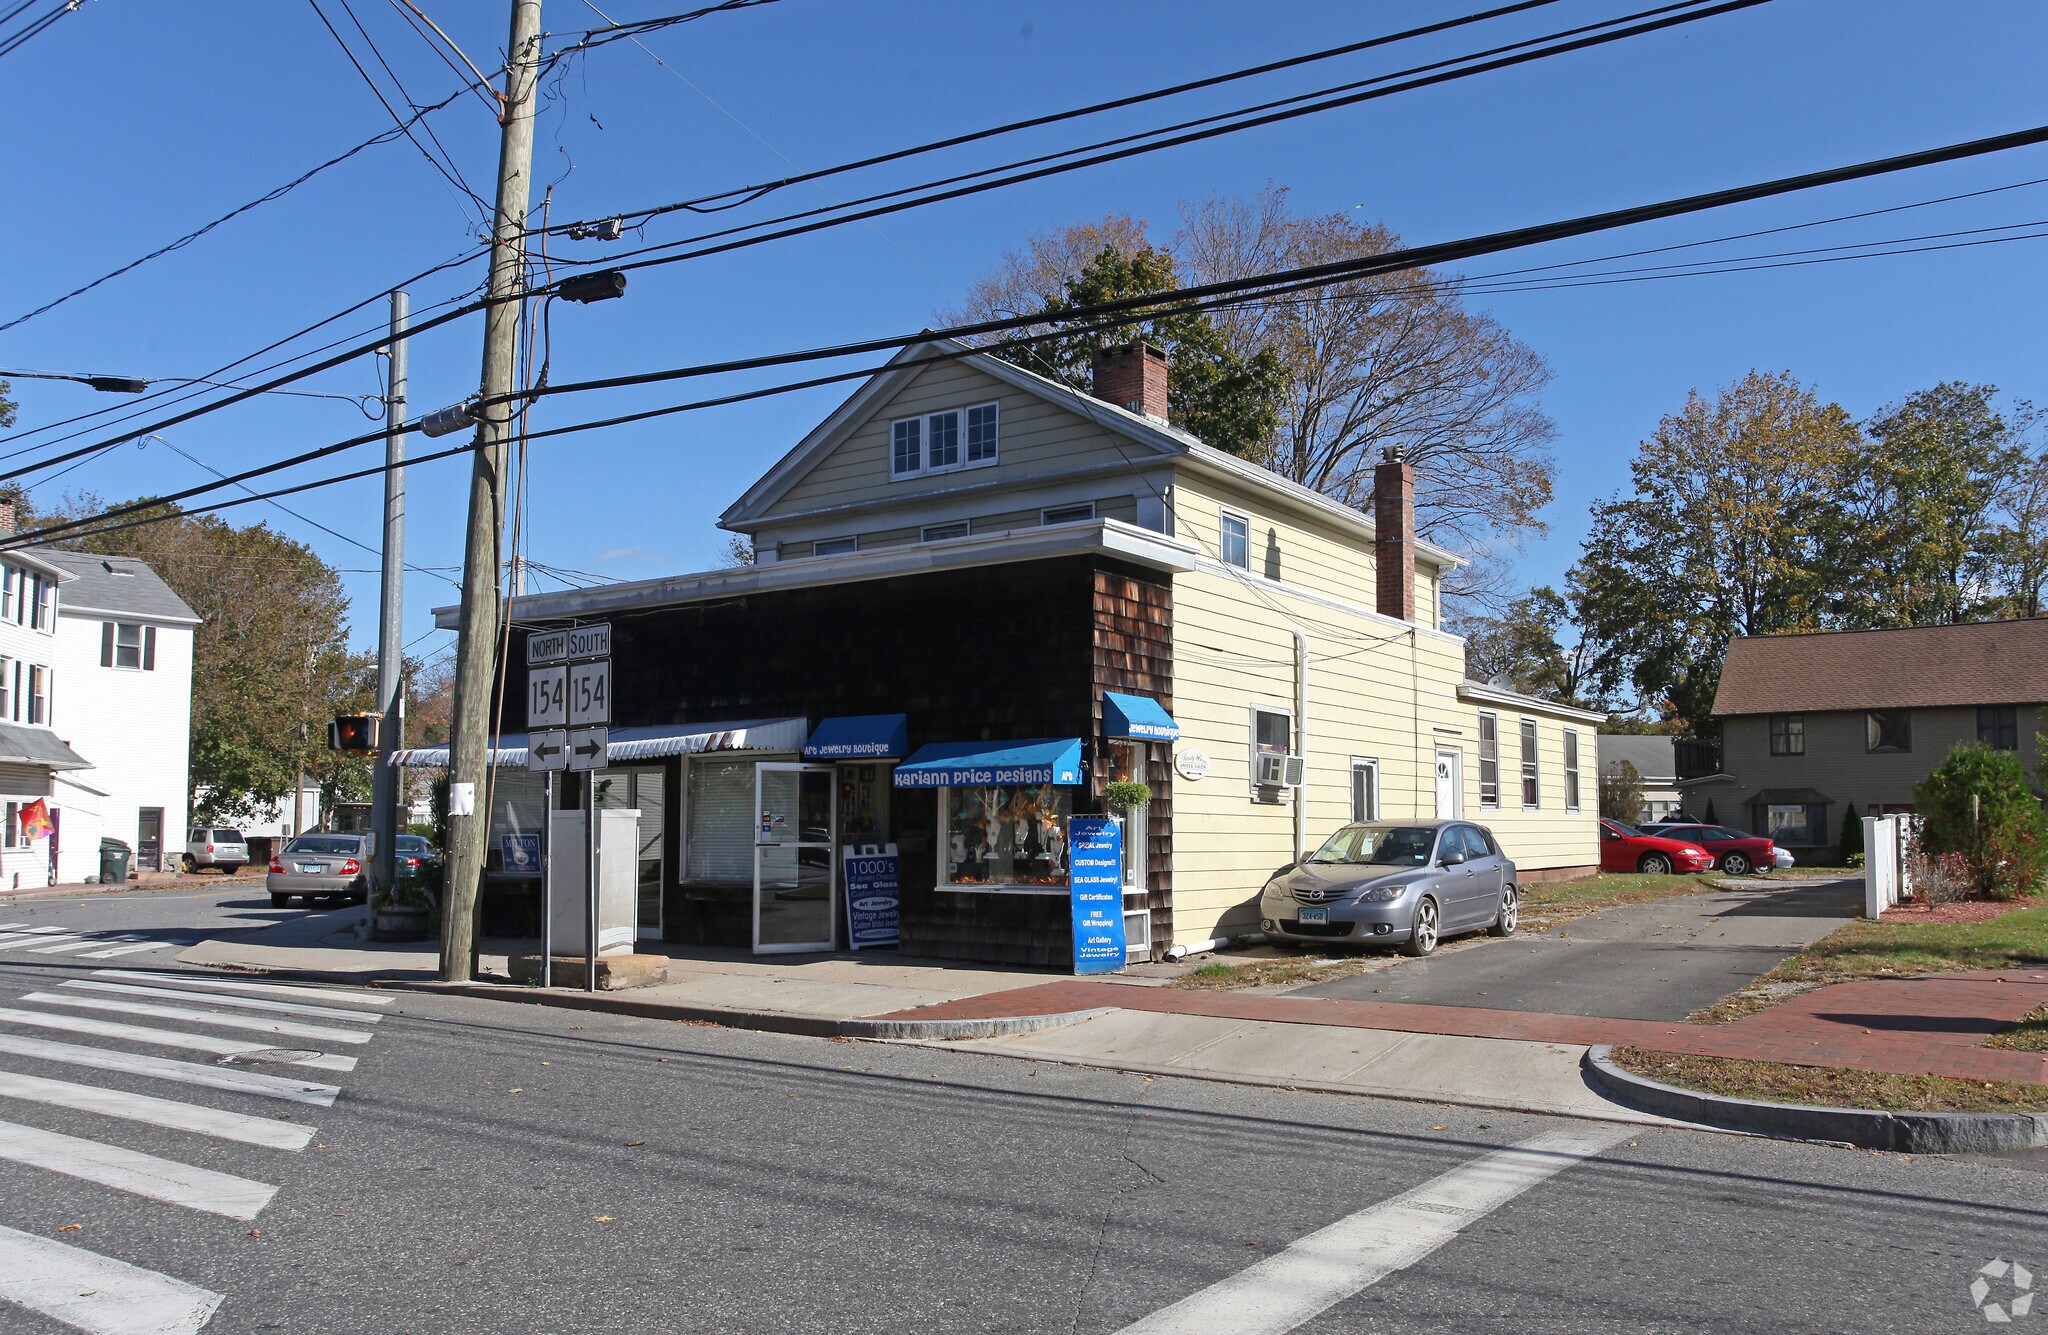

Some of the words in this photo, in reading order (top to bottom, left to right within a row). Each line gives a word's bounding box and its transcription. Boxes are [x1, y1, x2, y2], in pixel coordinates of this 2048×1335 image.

[533, 636, 564, 658] NORTH
[570, 632, 607, 655] SOUTH
[532, 678, 564, 715] 154
[573, 675, 605, 713] 154
[804, 746, 817, 755] Art
[820, 744, 852, 755] Jewelry
[853, 742, 889, 756] Boutique
[894, 770, 950, 786] Kariann
[953, 768, 992, 785] Price
[995, 767, 1051, 784] Designs
[505, 838, 536, 848] MLTON
[852, 860, 895, 875] 1000's
[1074, 859, 1094, 867] CUSTOM
[872, 881, 898, 889] Glass
[1074, 876, 1084, 884] SEA
[1084, 876, 1100, 884] GLASS
[853, 911, 877, 922] Vintage
[1090, 910, 1103, 918] FREE
